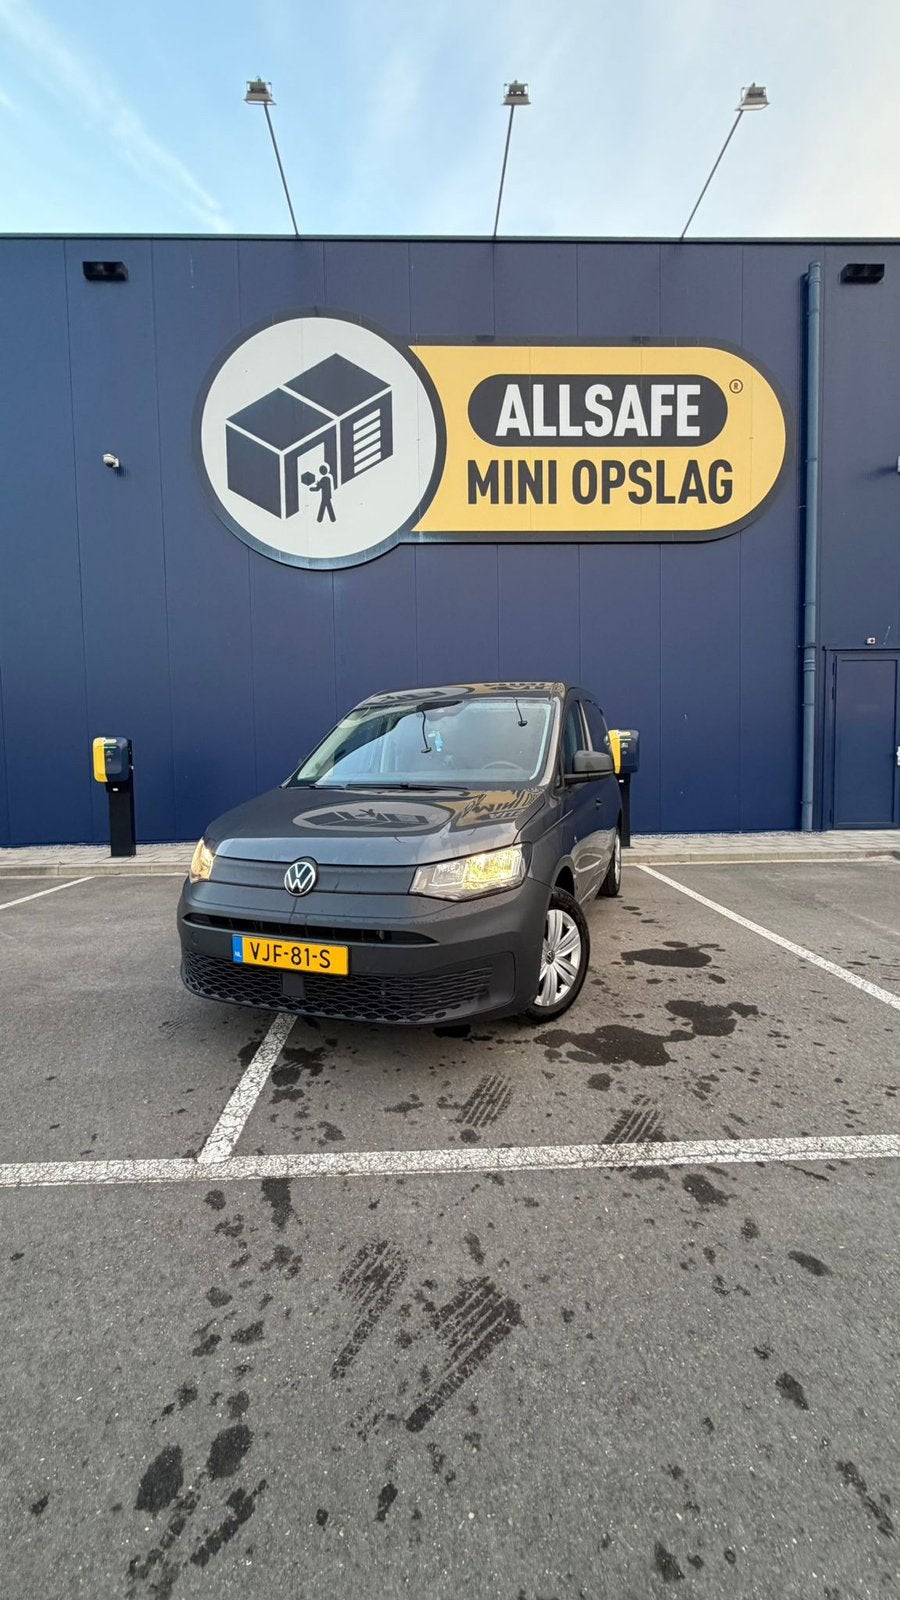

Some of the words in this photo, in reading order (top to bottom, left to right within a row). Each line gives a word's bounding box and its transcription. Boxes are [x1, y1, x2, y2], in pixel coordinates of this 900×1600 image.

[495, 384, 701, 437] ALLSAFE
[467, 459, 557, 505] MINI
[572, 459, 733, 505] OPSLAG
[249, 941, 331, 969] VJF-81-S
